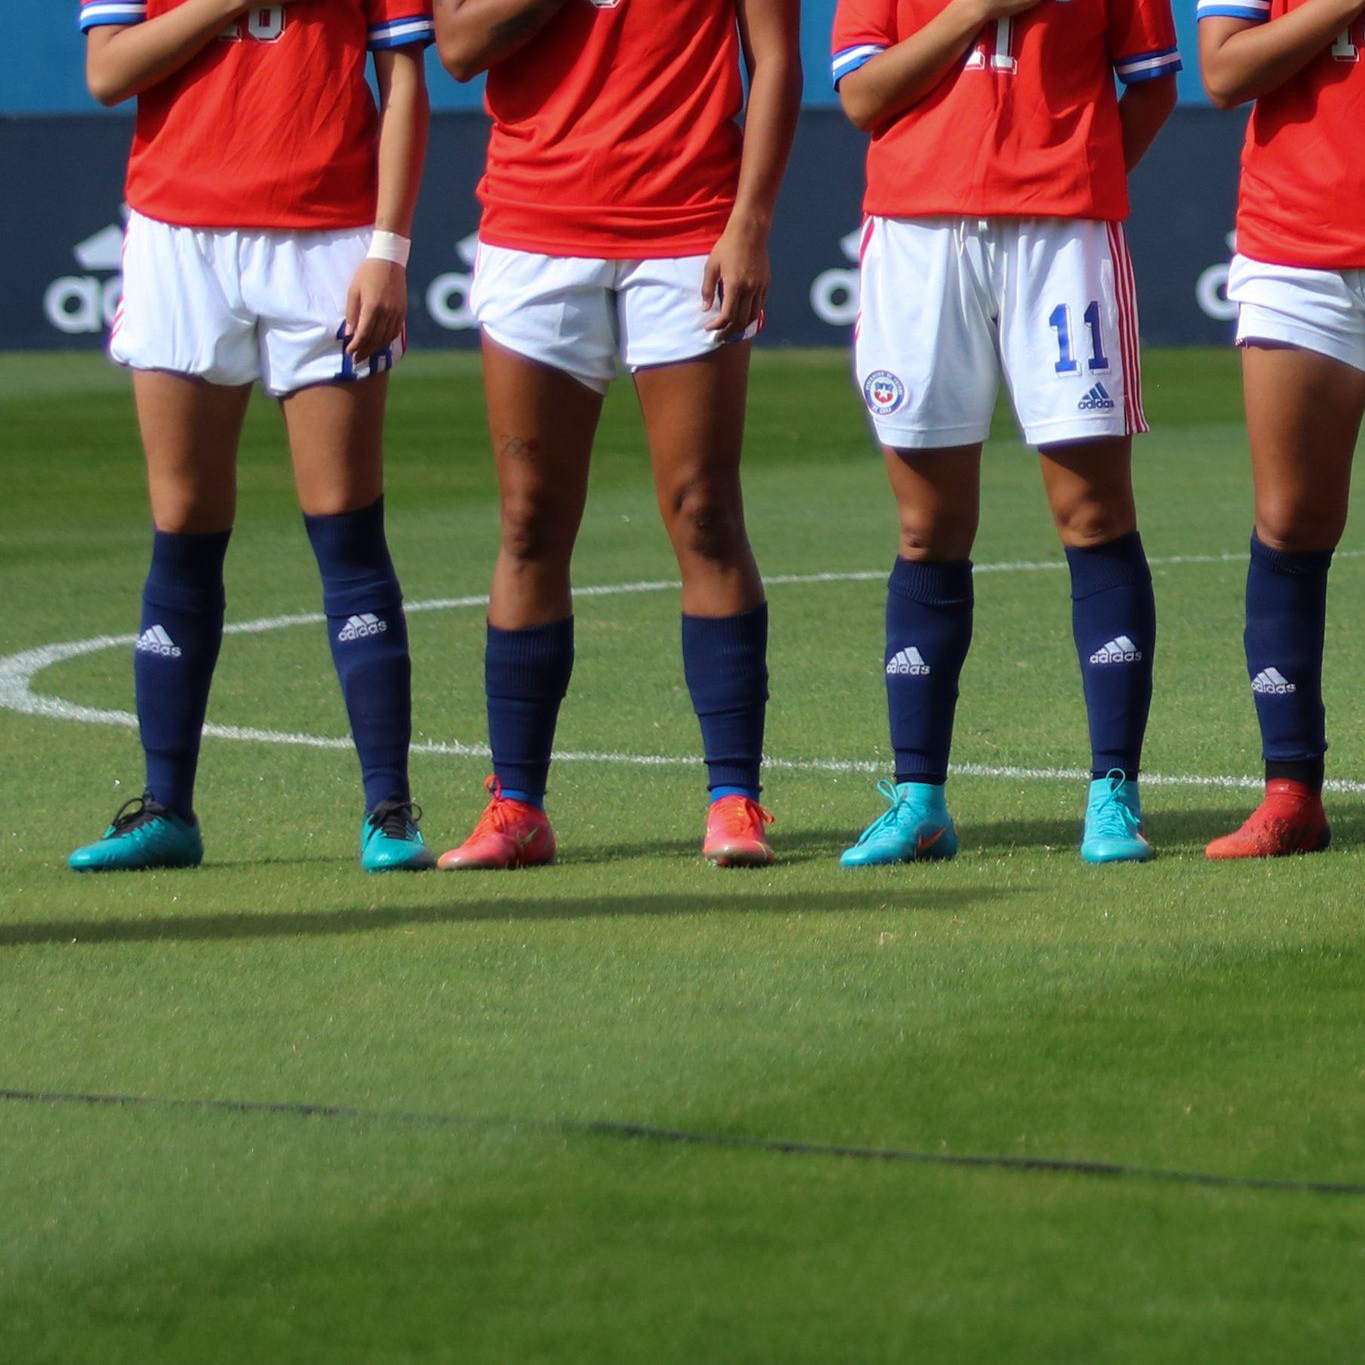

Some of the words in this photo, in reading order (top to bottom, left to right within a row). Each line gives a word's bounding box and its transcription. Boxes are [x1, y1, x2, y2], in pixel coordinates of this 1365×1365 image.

[1049, 300, 1112, 378] 11
[1078, 398, 1115, 411] adidas
[338, 620, 388, 642] adidas
[136, 638, 182, 658] adidas
[1090, 650, 1143, 665] adidas
[886, 662, 931, 676] adidas
[1251, 681, 1297, 694] adidas
